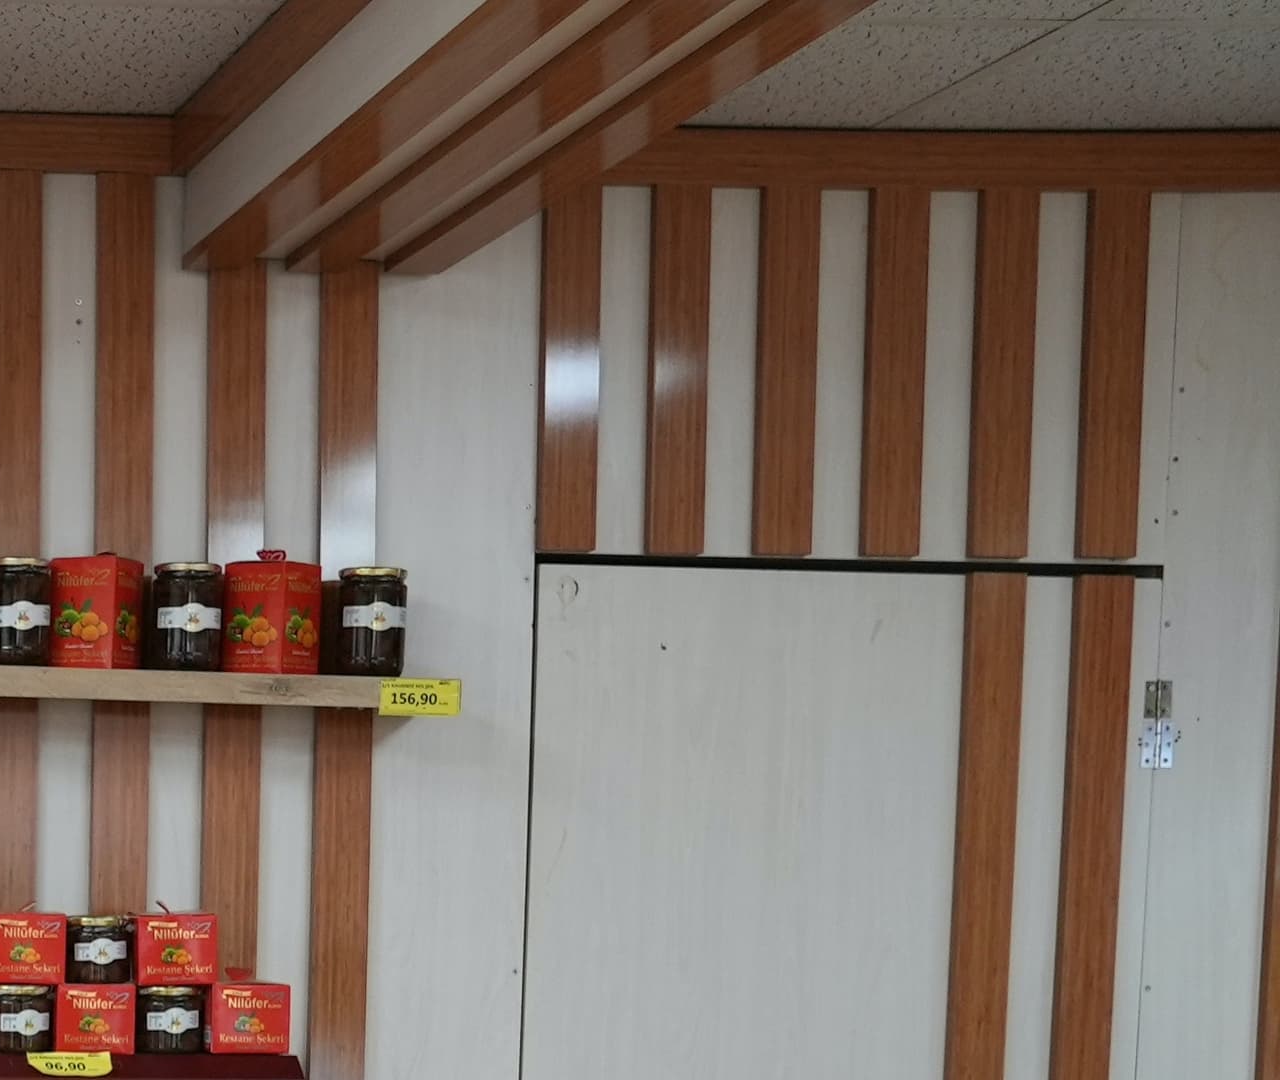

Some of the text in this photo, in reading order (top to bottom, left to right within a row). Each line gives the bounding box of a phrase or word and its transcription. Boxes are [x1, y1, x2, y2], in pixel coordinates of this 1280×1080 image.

[389, 692, 438, 706] 156,90
[3, 925, 45, 939] Nilüfer
[153, 927, 196, 940] Nilüfer
[146, 964, 183, 975] Kestane
[72, 995, 113, 1009] Nilüfer
[227, 995, 269, 1009] Nilüfer
[45, 1062, 87, 1073] 96,90
